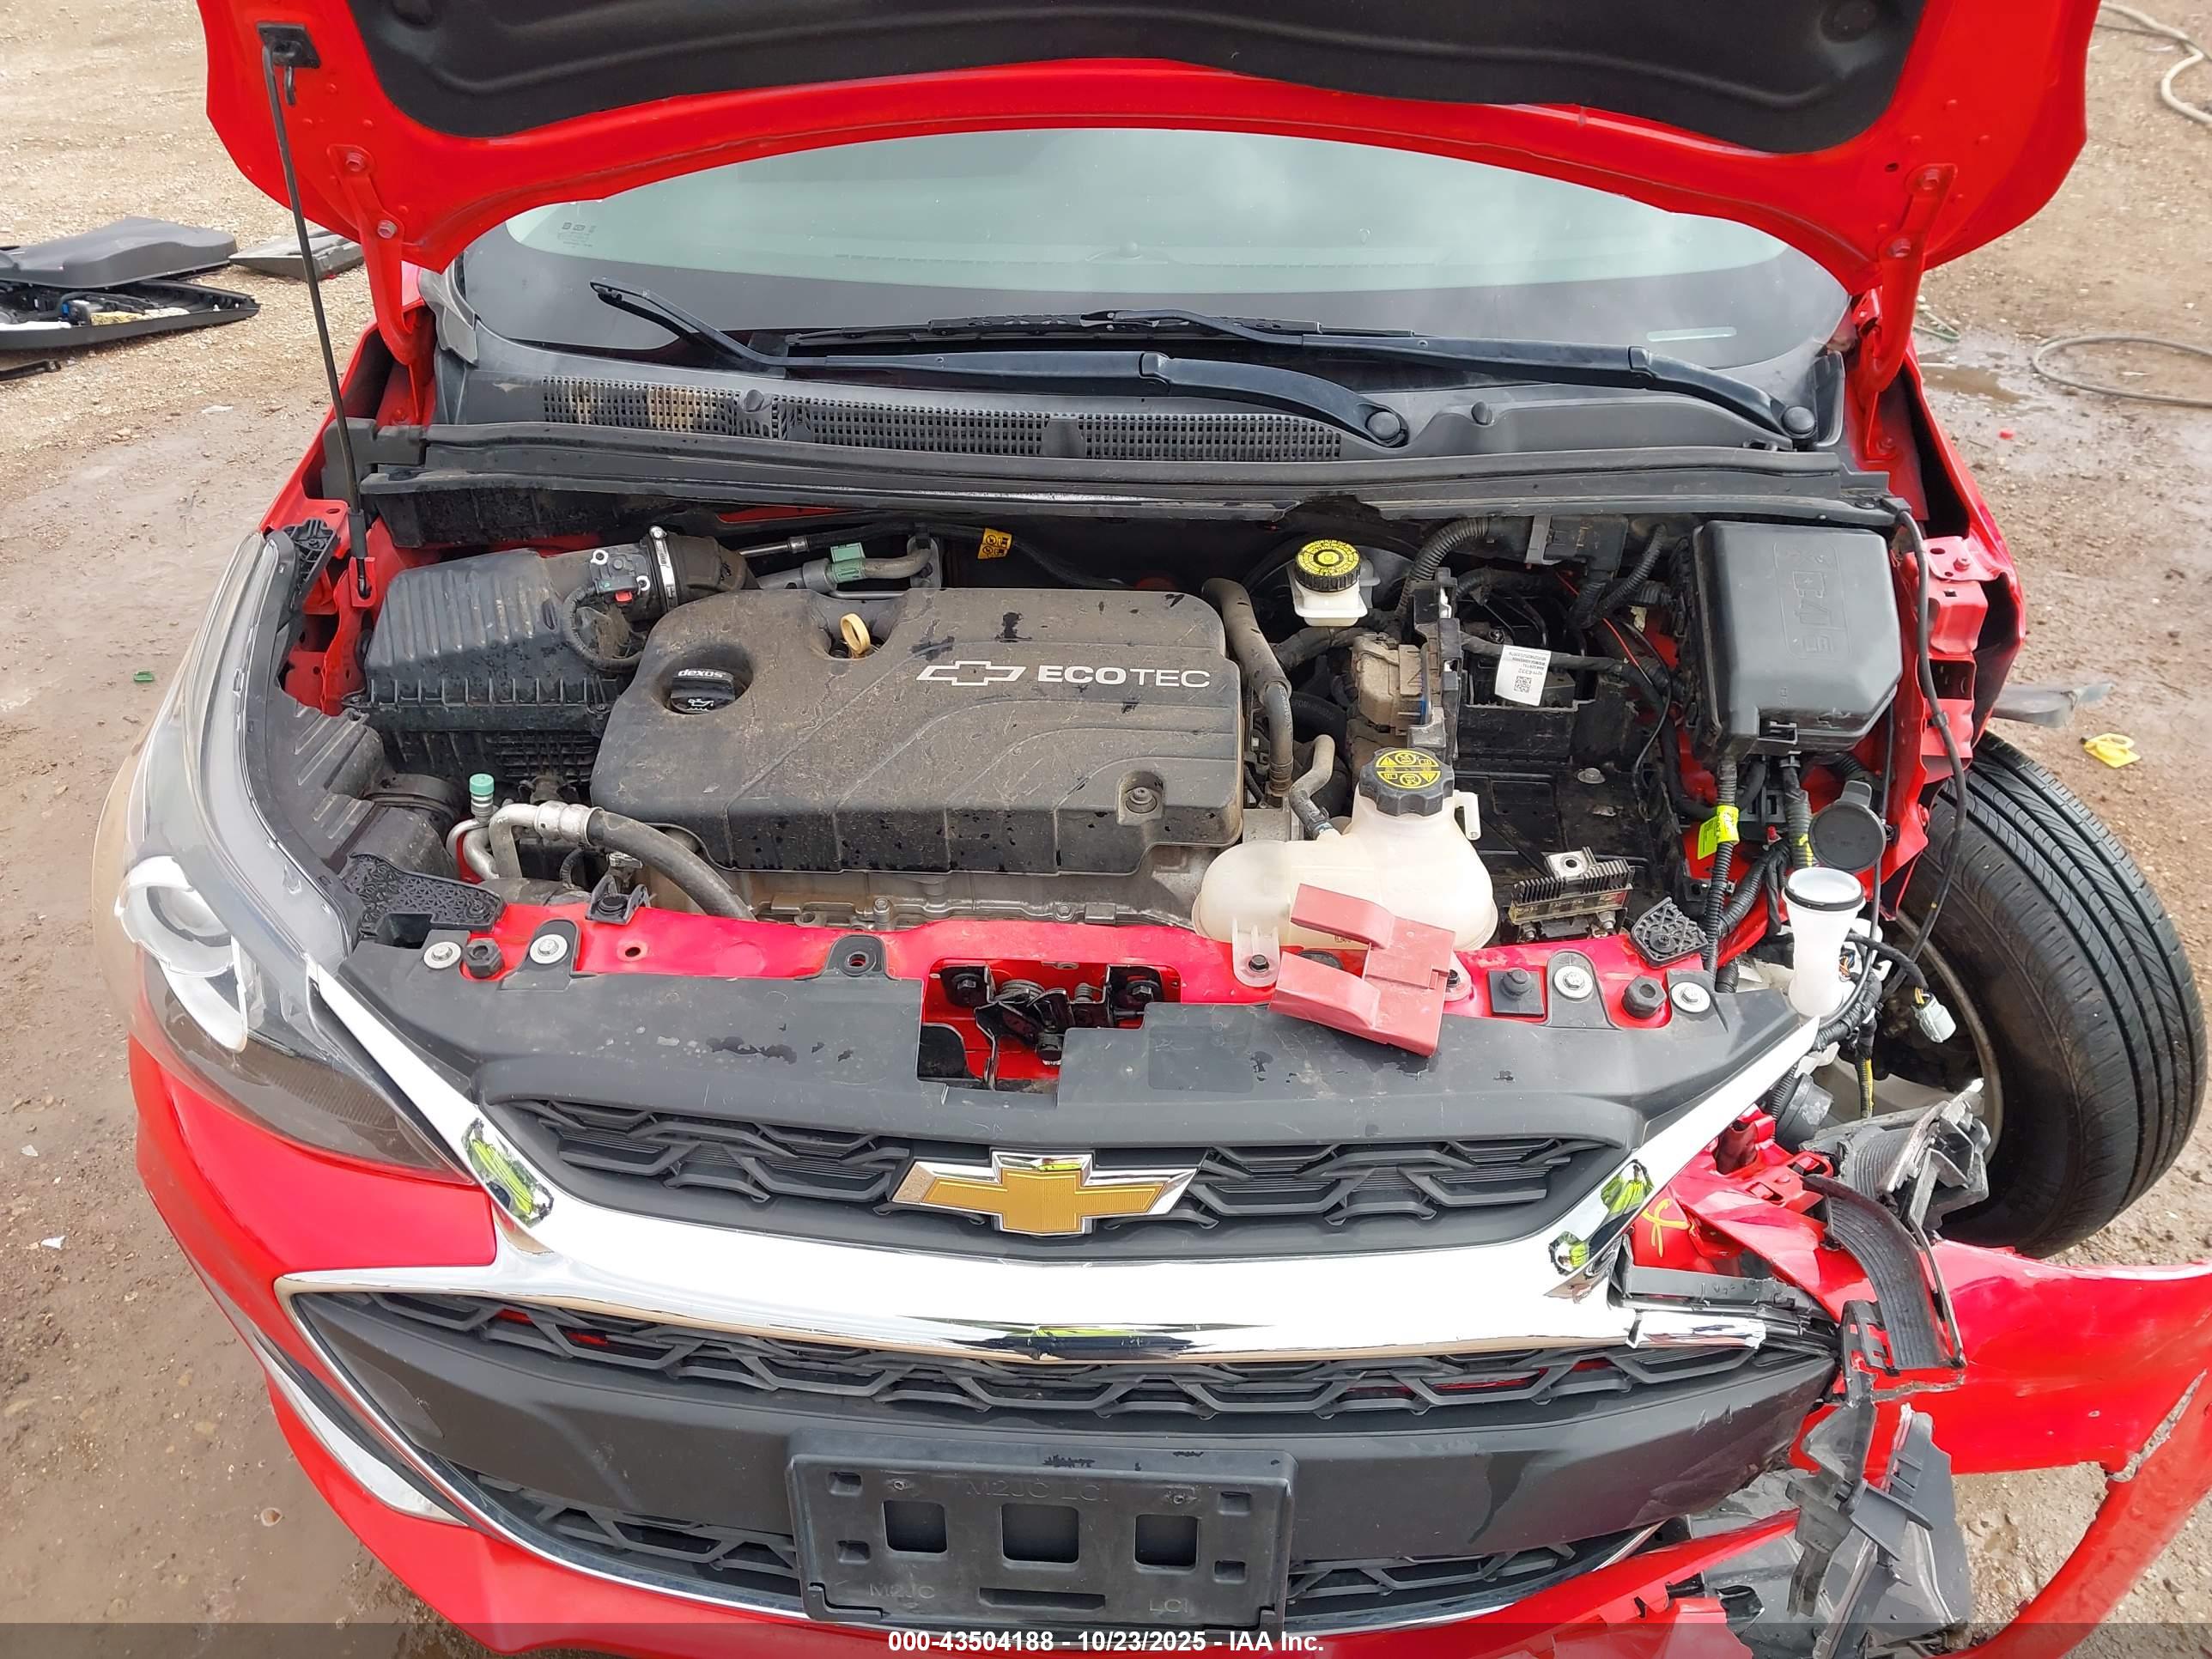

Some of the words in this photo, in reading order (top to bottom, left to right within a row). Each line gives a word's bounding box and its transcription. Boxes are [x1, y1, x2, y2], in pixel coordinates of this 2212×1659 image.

[678, 669, 726, 678] dexos
[1037, 665, 1211, 688] ECOTEC
[966, 1480, 1050, 1498] M2JC
[868, 1583, 936, 1600] M2JC
